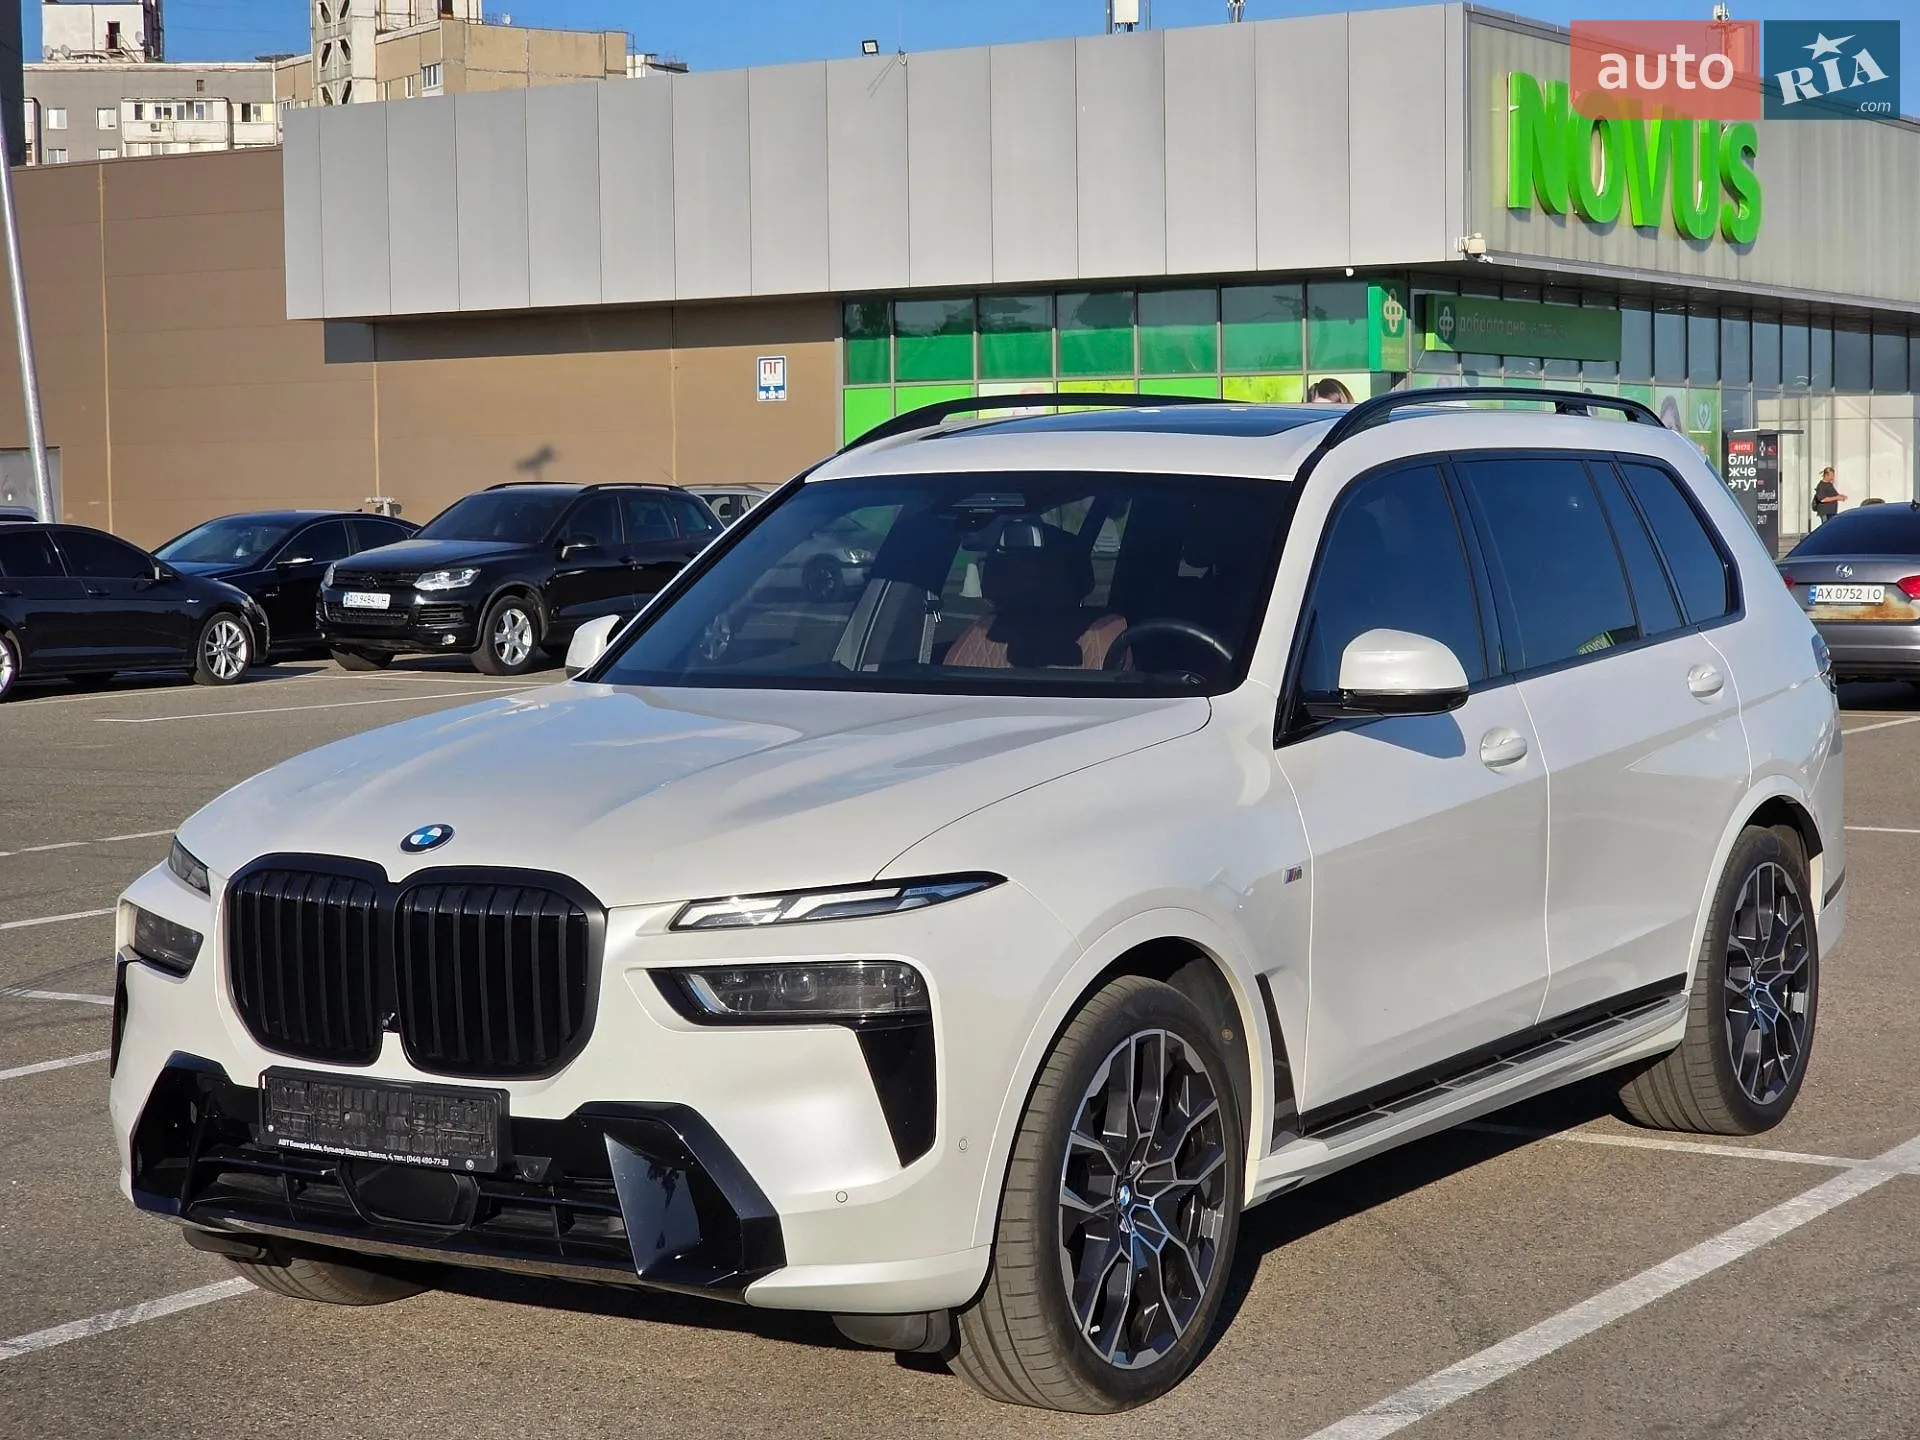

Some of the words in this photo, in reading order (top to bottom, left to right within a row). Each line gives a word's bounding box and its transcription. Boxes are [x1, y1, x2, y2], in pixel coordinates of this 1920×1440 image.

[1507, 71, 1762, 244] NOVUS
[1728, 466, 1757, 477] жче
[1737, 479, 1757, 491] тут
[1817, 588, 1833, 599] AX
[1836, 588, 1862, 599] 0752
[1867, 588, 1882, 600] IO
